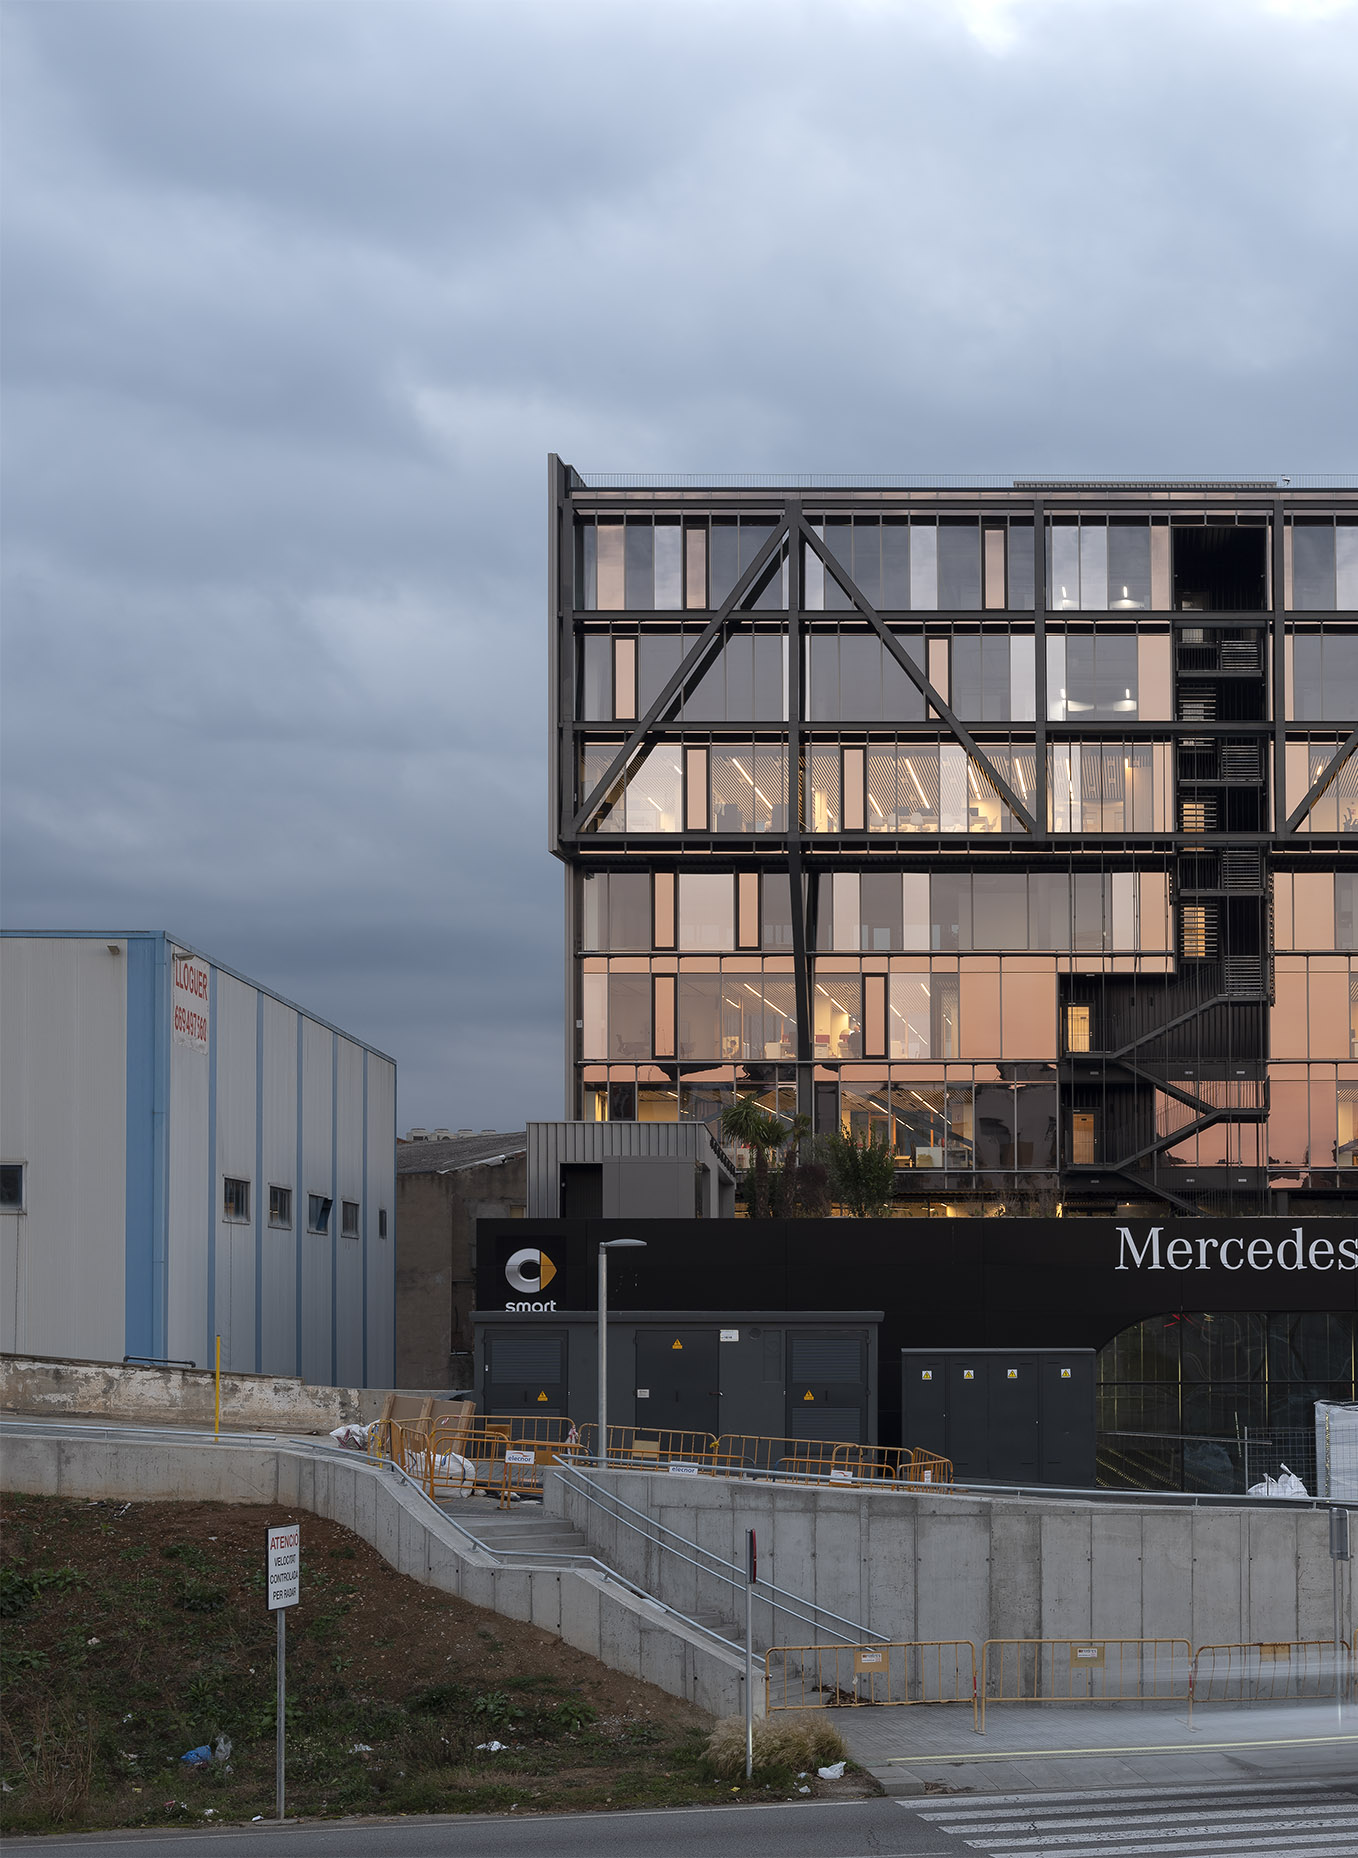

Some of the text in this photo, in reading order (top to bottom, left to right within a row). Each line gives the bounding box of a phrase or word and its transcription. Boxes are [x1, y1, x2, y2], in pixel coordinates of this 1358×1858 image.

[175, 959, 208, 1001] LLOGUER
[505, 1300, 557, 1312] smart
[270, 1529, 299, 1551] ATENCIÓ
[274, 1554, 297, 1567] VELOCITAT
[269, 1570, 299, 1585] CONTROLADA
[272, 1587, 297, 1601] PER RADAR
